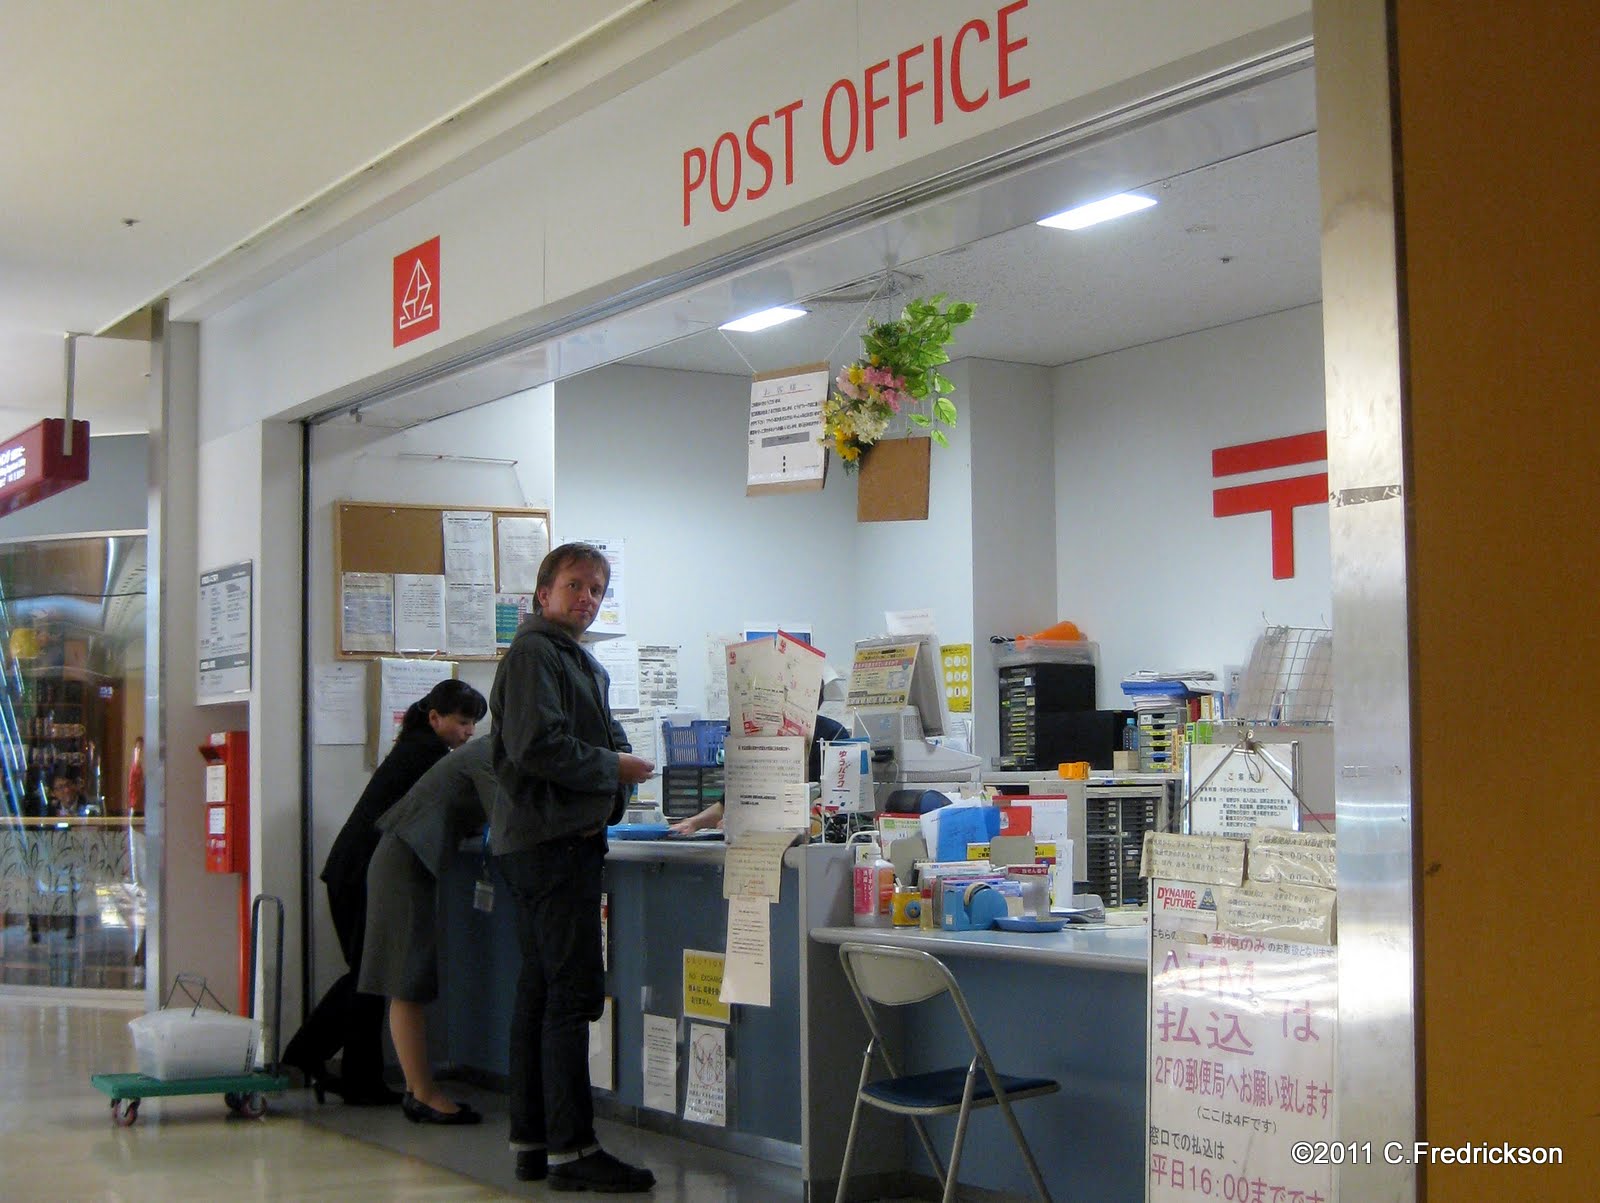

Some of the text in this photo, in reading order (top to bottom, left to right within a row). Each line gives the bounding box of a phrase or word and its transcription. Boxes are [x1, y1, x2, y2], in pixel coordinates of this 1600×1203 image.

[683, 0, 1031, 227] POST OFFICE
[1157, 887, 1196, 899] DYNAMIC
[1163, 897, 1197, 909] FUTURE
[1156, 1001, 1255, 1056] 払込
[1155, 1055, 1333, 1120] 2Fの郵便局へお願い致します
[1197, 1105, 1277, 1135] (ここは4Fです)
